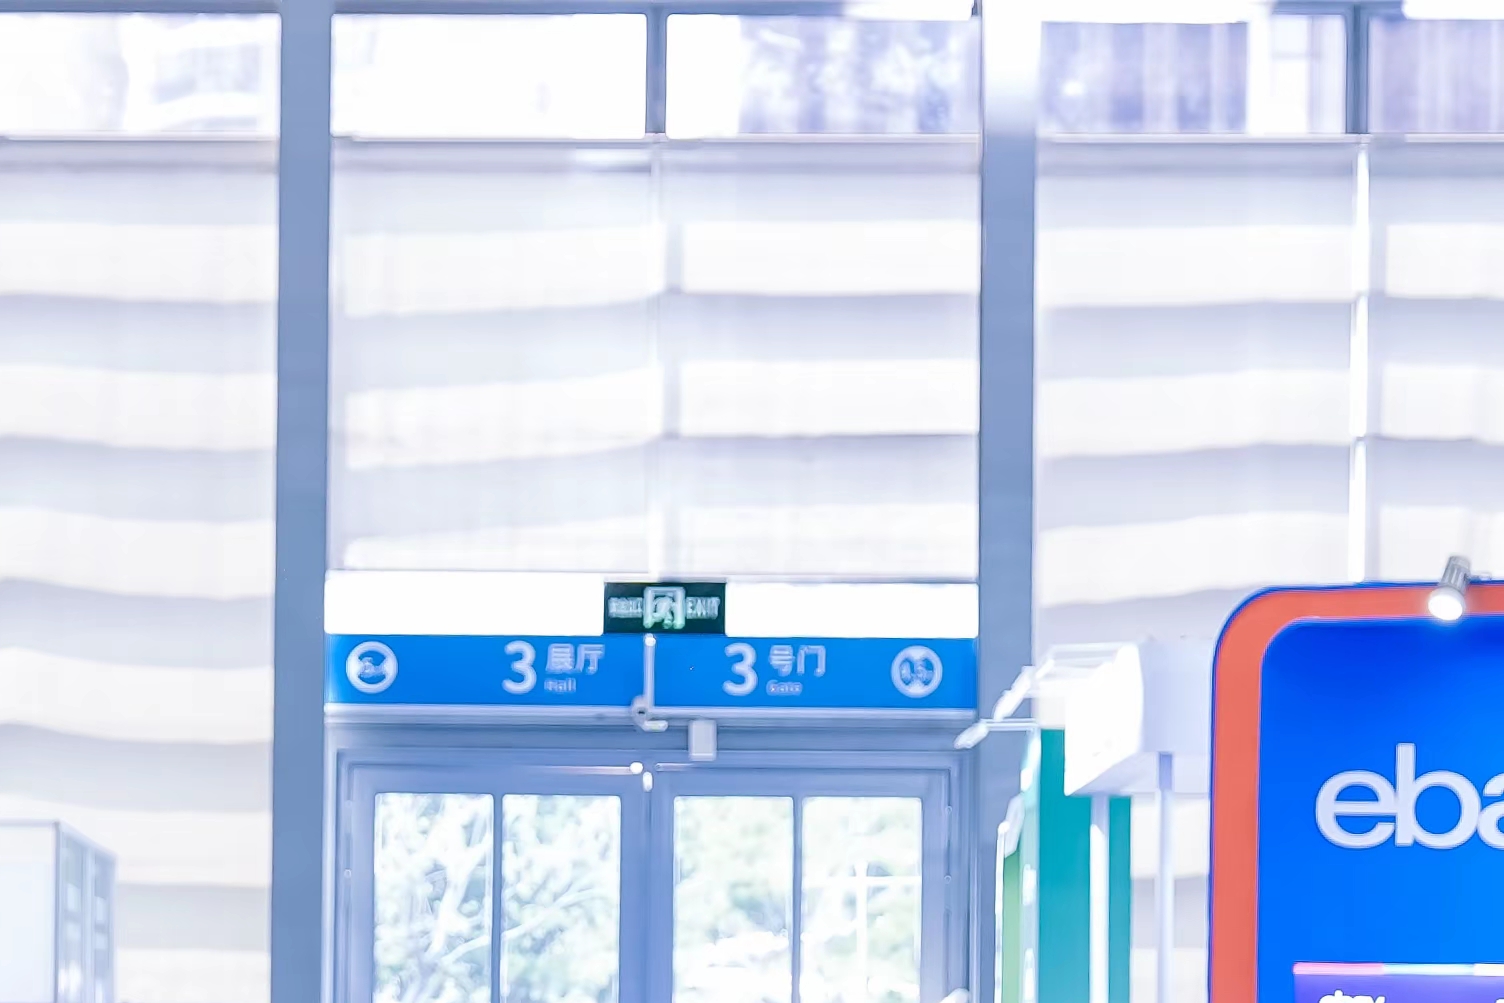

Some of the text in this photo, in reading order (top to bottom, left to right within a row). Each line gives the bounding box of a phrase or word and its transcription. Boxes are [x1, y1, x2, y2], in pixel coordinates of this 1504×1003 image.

[502, 640, 606, 694] 3 展厅
[723, 642, 826, 696] 3 号门
